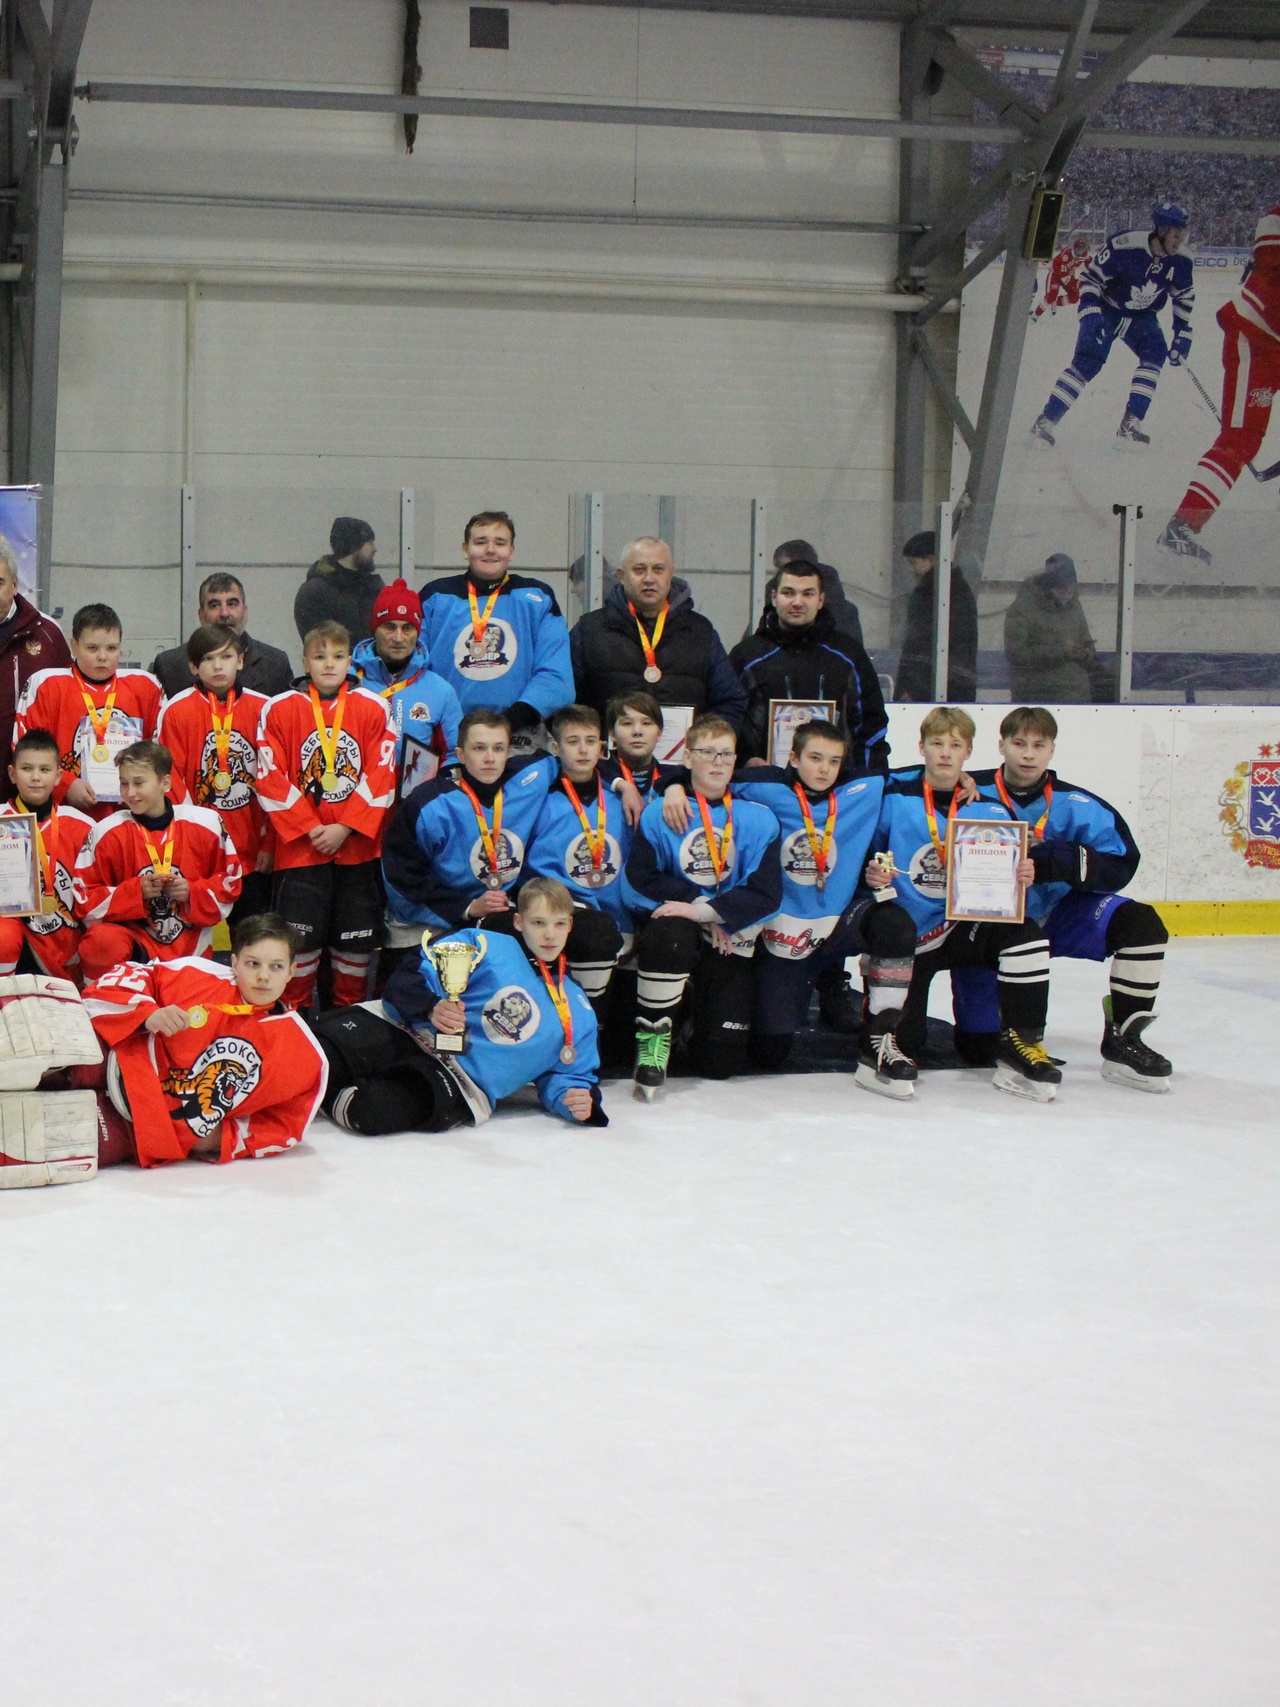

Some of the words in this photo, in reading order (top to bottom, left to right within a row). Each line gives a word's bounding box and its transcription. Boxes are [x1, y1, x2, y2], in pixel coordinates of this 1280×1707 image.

[1193, 257, 1228, 268] EICO
[968, 848, 1007, 856] ДИПЛОМ
[340, 929, 373, 940] EFSI
[96, 964, 150, 992] 22
[493, 1012, 517, 1034] СЕВЕР
